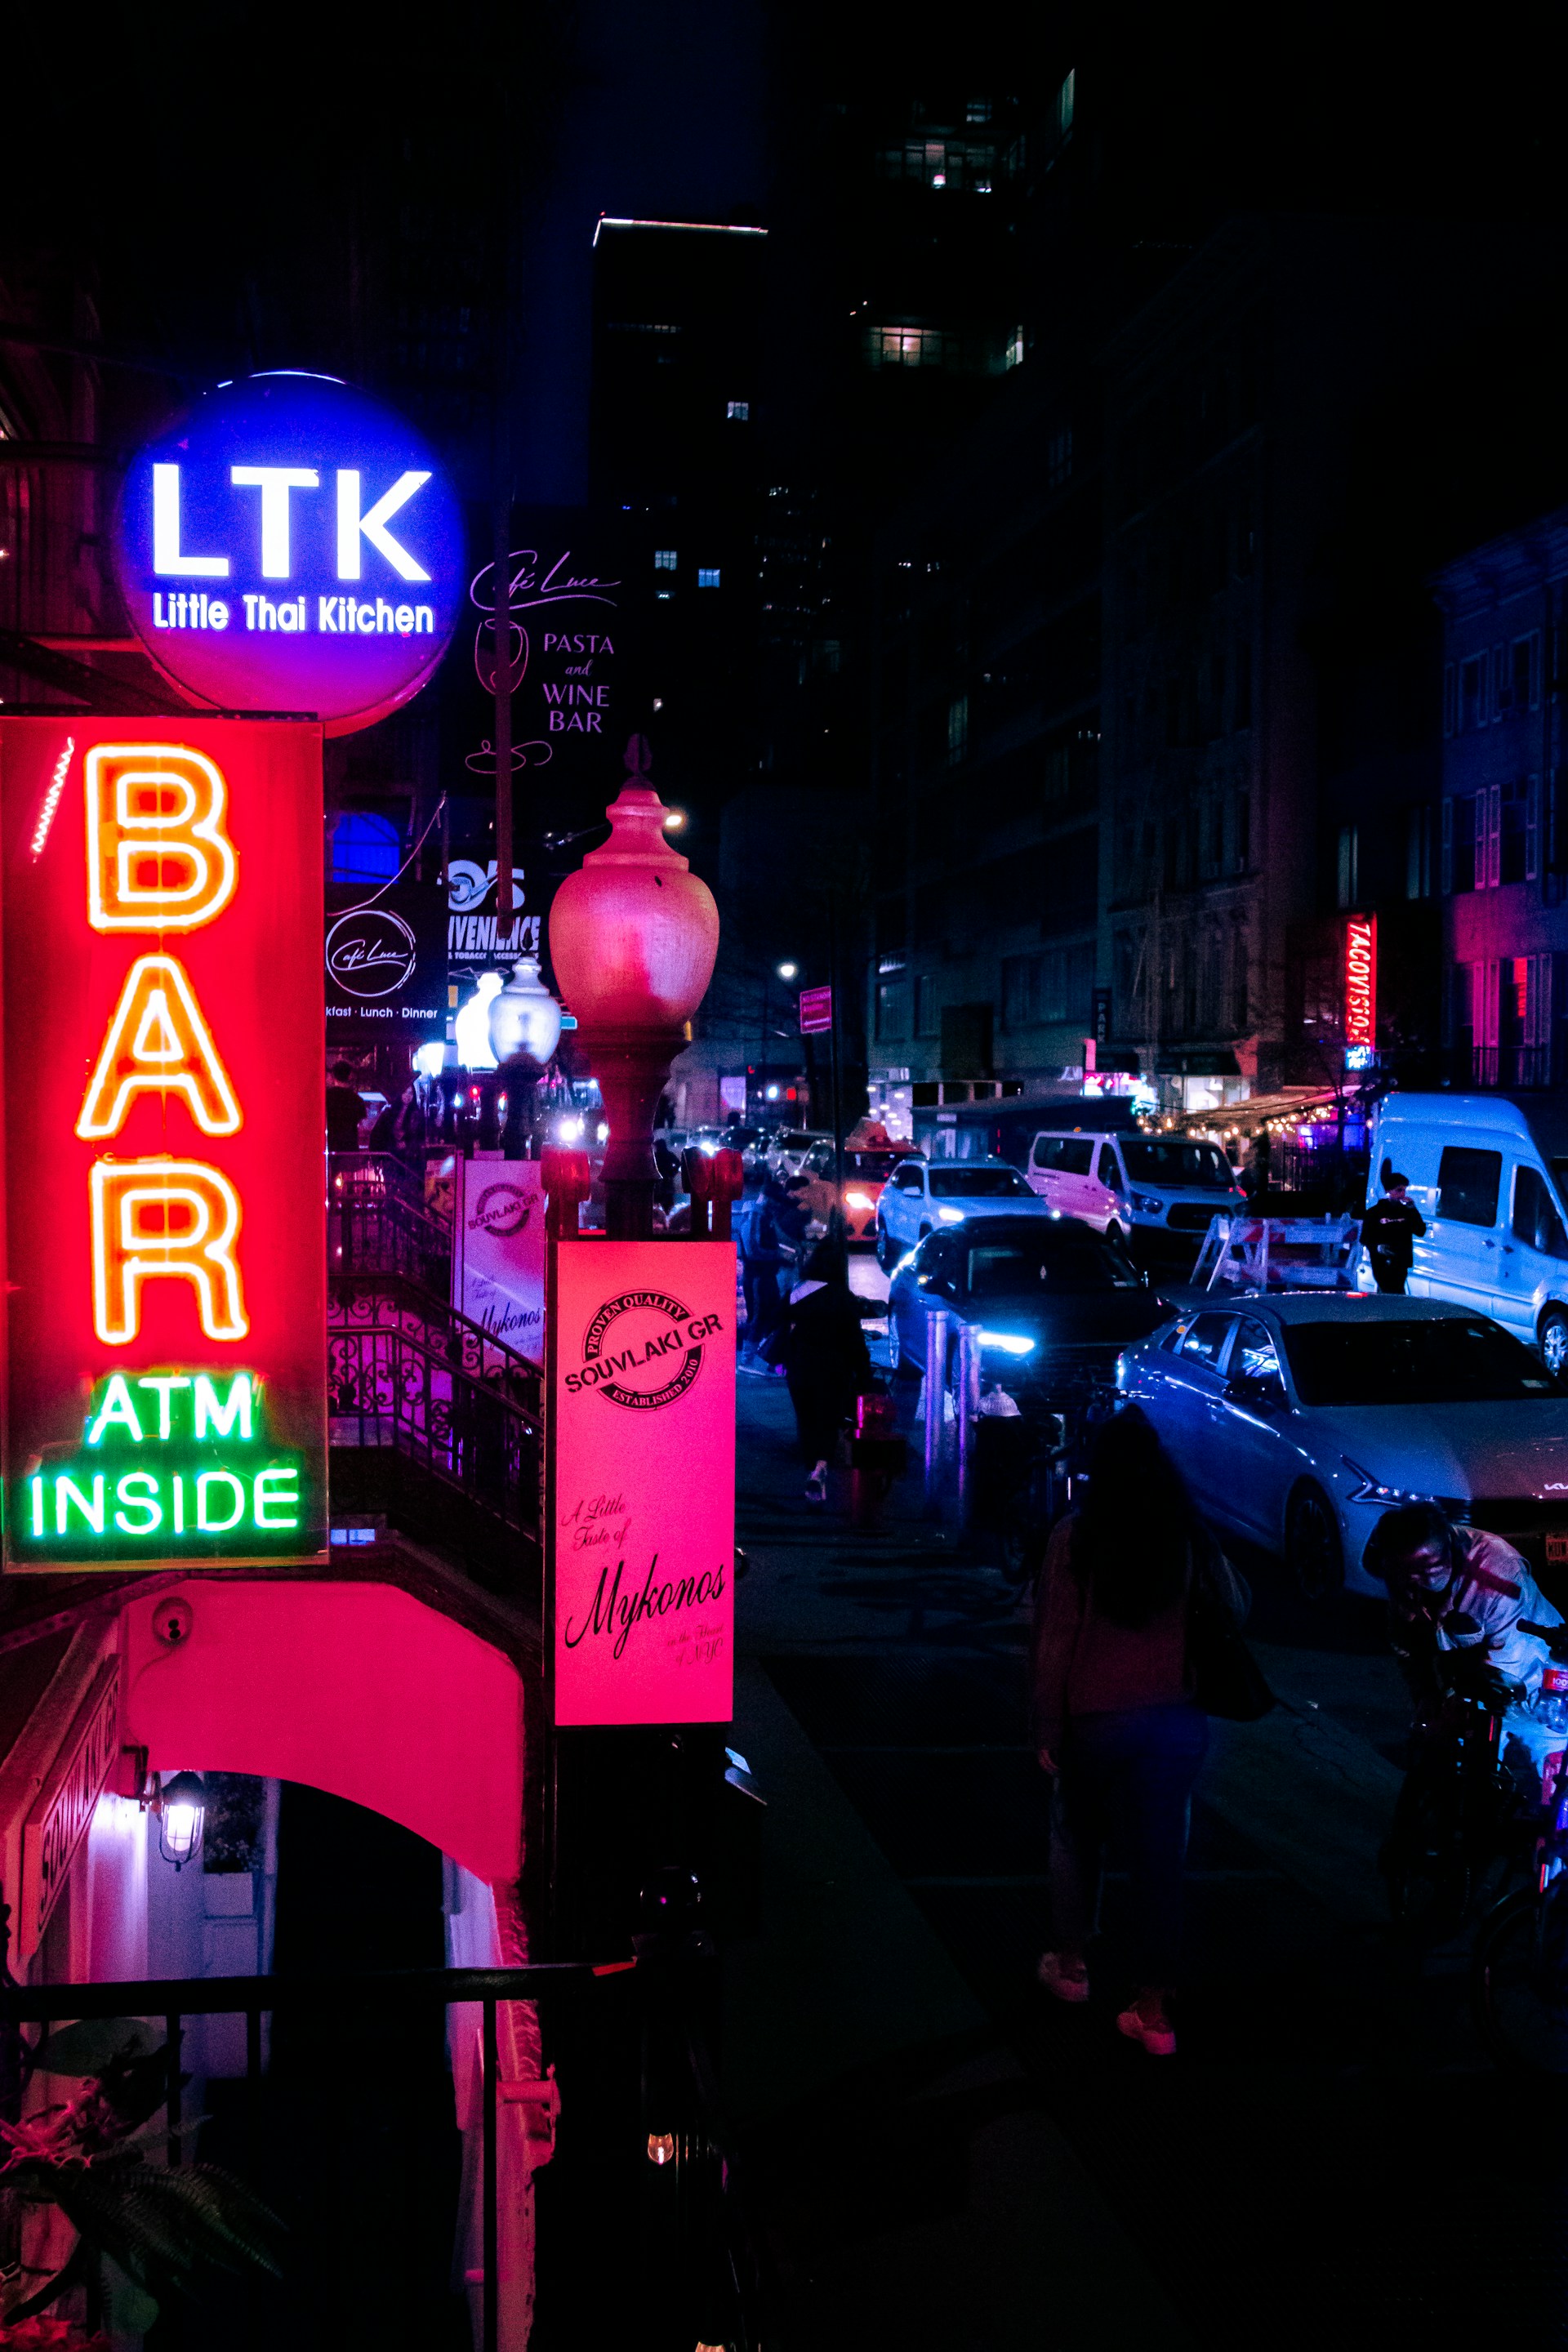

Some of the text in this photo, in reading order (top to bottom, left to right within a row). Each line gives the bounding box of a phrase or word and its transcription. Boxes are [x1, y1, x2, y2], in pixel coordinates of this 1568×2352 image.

[153, 463, 432, 581] LTK
[541, 551, 621, 593] Luce
[153, 593, 434, 633] Little Thai Kitchen
[544, 633, 614, 654] PASTA
[564, 659, 594, 677] and
[542, 683, 610, 707] WINE
[550, 710, 603, 733] BAR
[367, 939, 408, 961] Luce
[360, 1007, 393, 1018] Lunch
[402, 1008, 438, 1018] Dinner
[74, 742, 250, 1346] BAR
[468, 1201, 521, 1230] SOUVLAKI
[587, 1301, 626, 1354] PROVEN
[622, 1294, 686, 1320] QUALITY
[564, 1313, 724, 1393] SOUVLAKI GR
[612, 1358, 699, 1406] ESTABLISHED 2010
[87, 1371, 256, 1444] ATM
[29, 1468, 300, 1538] INSIDE
[561, 1493, 626, 1526] A Little
[572, 1517, 631, 1551] Taste of
[565, 1552, 725, 1659] Mykonos
[1552, 1677, 1568, 1686] 100
[40, 1709, 102, 1919] SOUVLAKI
